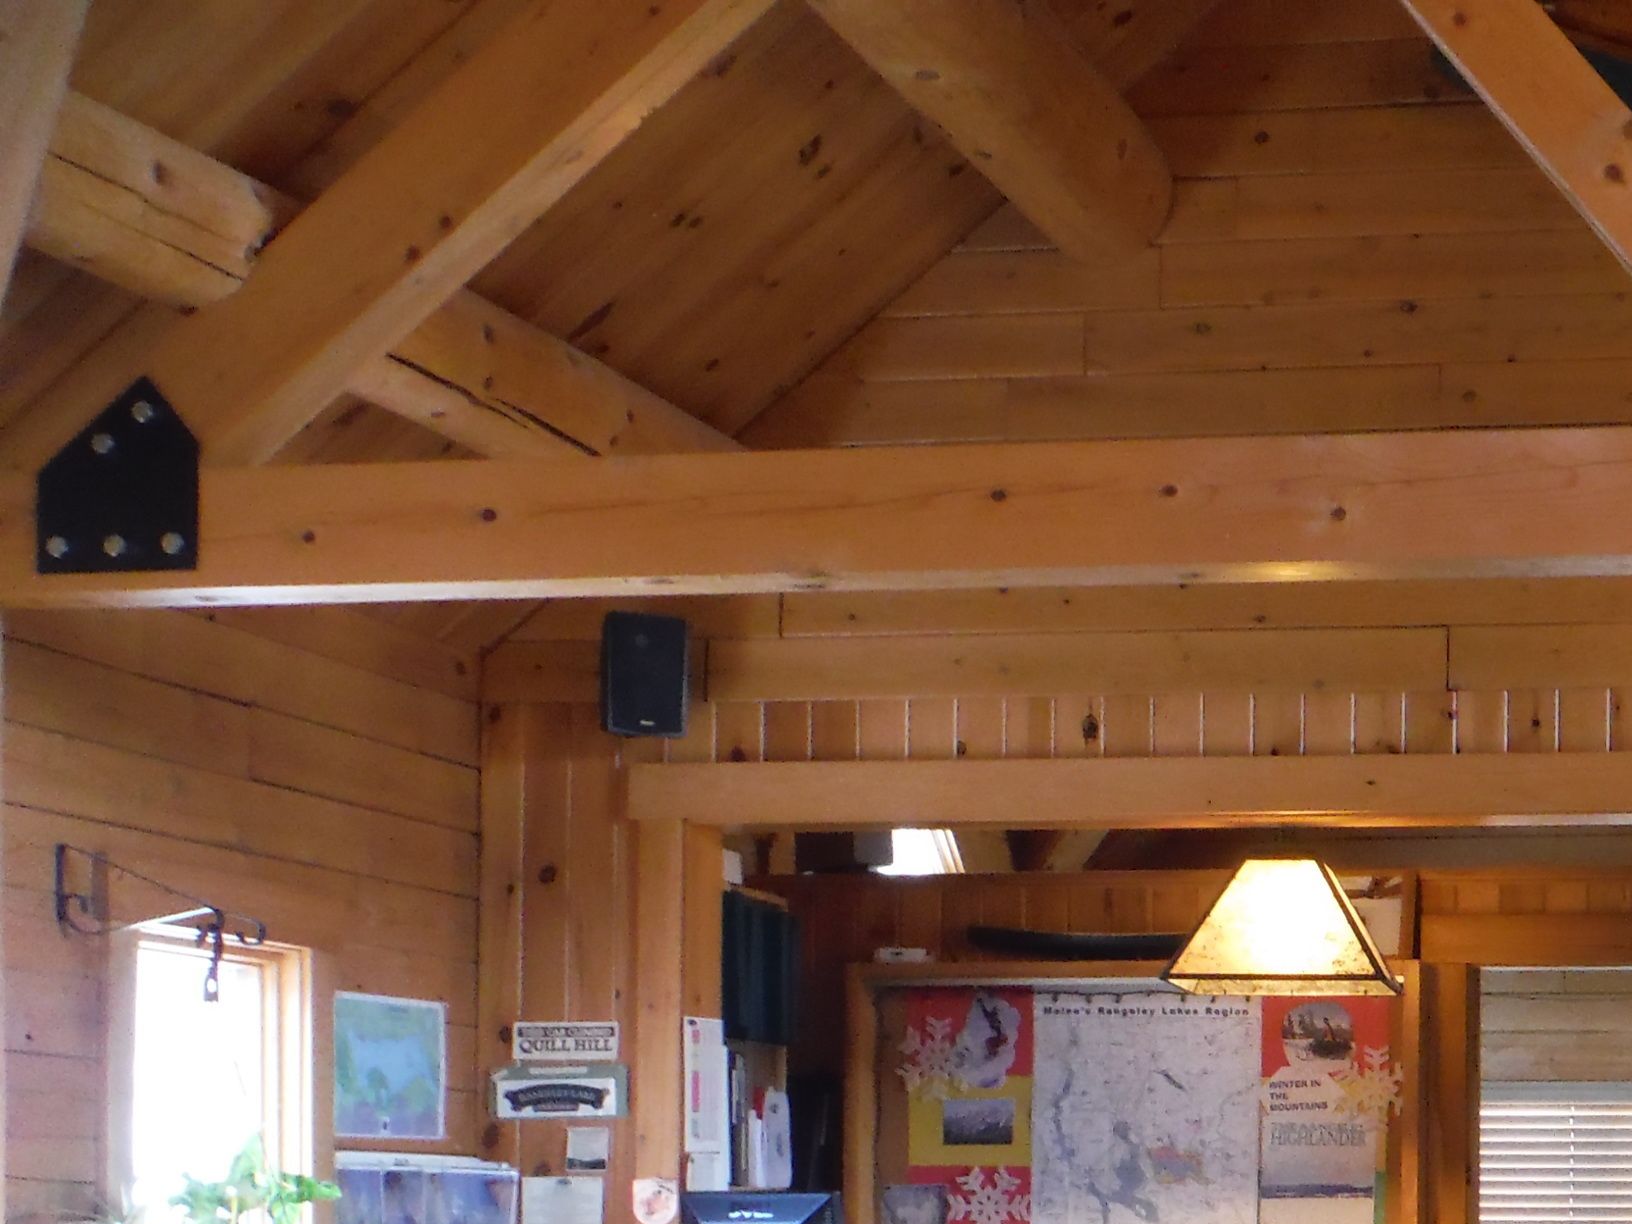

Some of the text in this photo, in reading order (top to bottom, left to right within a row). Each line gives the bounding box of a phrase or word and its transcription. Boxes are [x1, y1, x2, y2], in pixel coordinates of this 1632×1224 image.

[1044, 1006, 1250, 1018] Maine's Rangeley Lakes Region
[519, 1039, 613, 1053] QUILL HILL
[1269, 1081, 1308, 1089] WINTER
[1270, 1092, 1288, 1100] THE
[1269, 1101, 1329, 1112] MOUNTAINS
